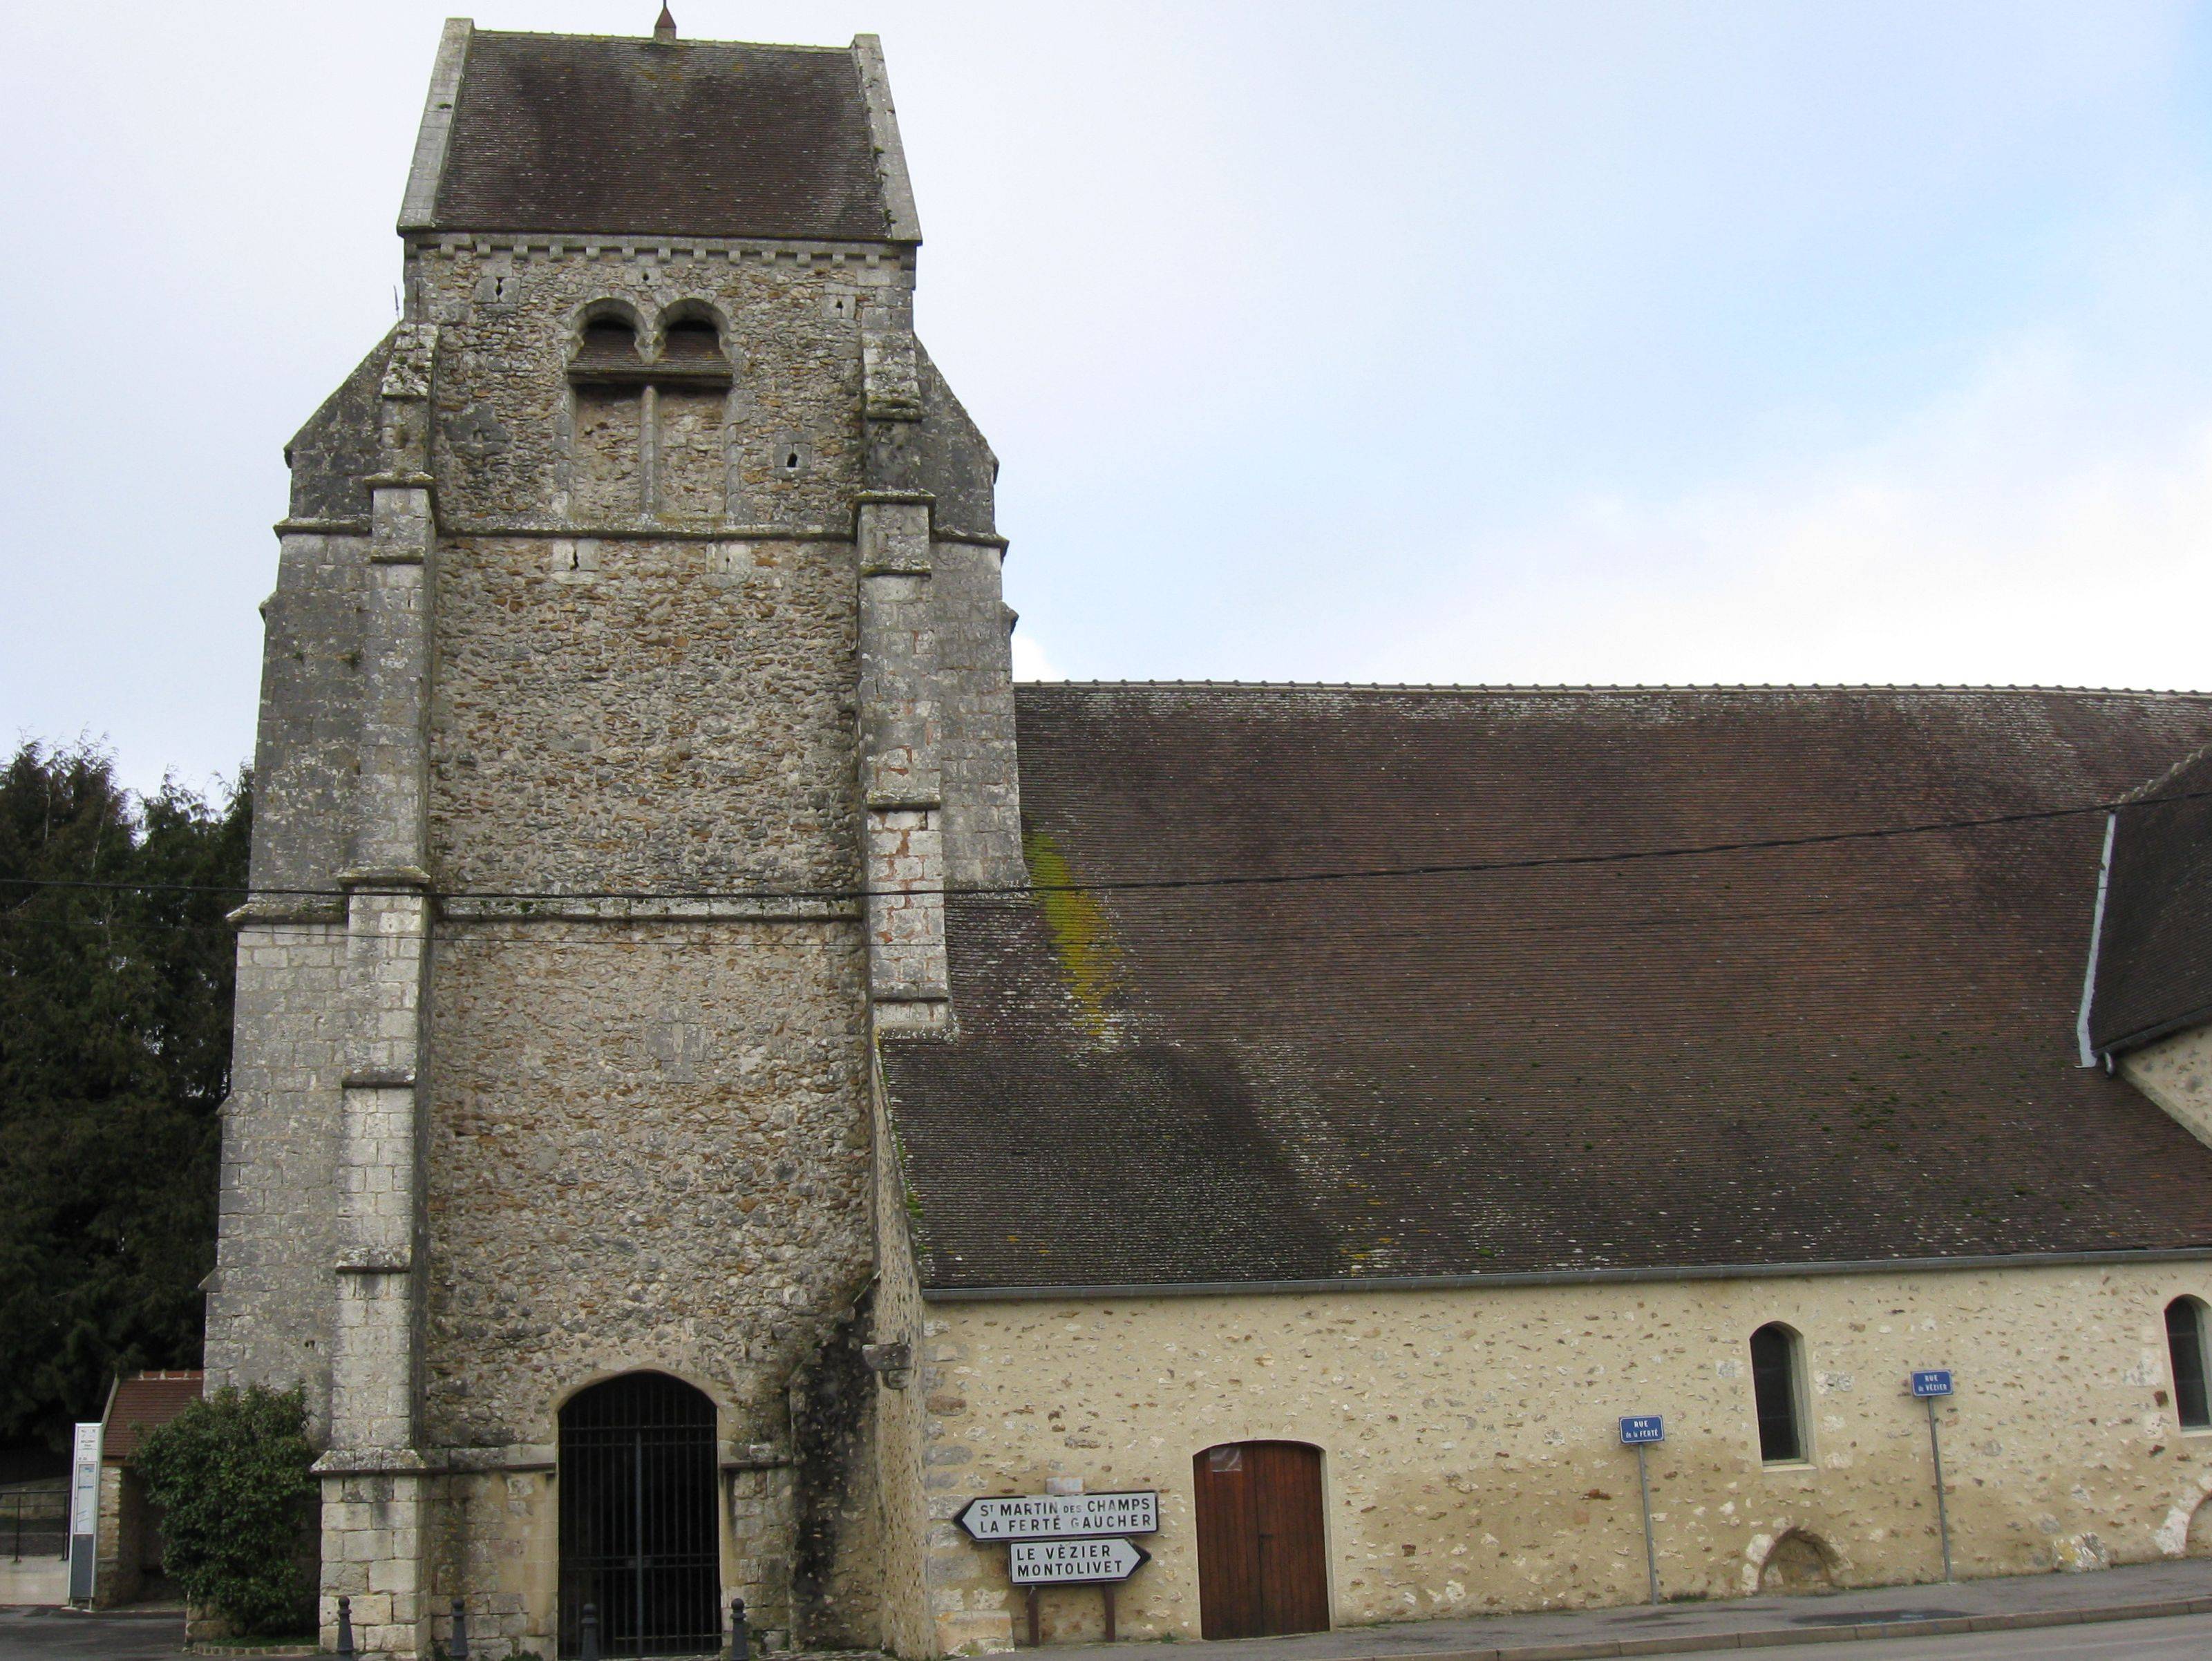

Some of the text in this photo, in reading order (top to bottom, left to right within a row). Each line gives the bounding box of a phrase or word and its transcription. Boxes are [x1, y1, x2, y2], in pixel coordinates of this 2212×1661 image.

[1001, 1501, 1059, 1517] MARTIN
[1064, 1505, 1082, 1514] DES
[1088, 1498, 1151, 1512] CHAMPS
[980, 1514, 1152, 1533] LA FERTÉ GAUCHER
[1017, 1548, 1036, 1561] LE
[1018, 1561, 1123, 1577] MONTOLIVET
